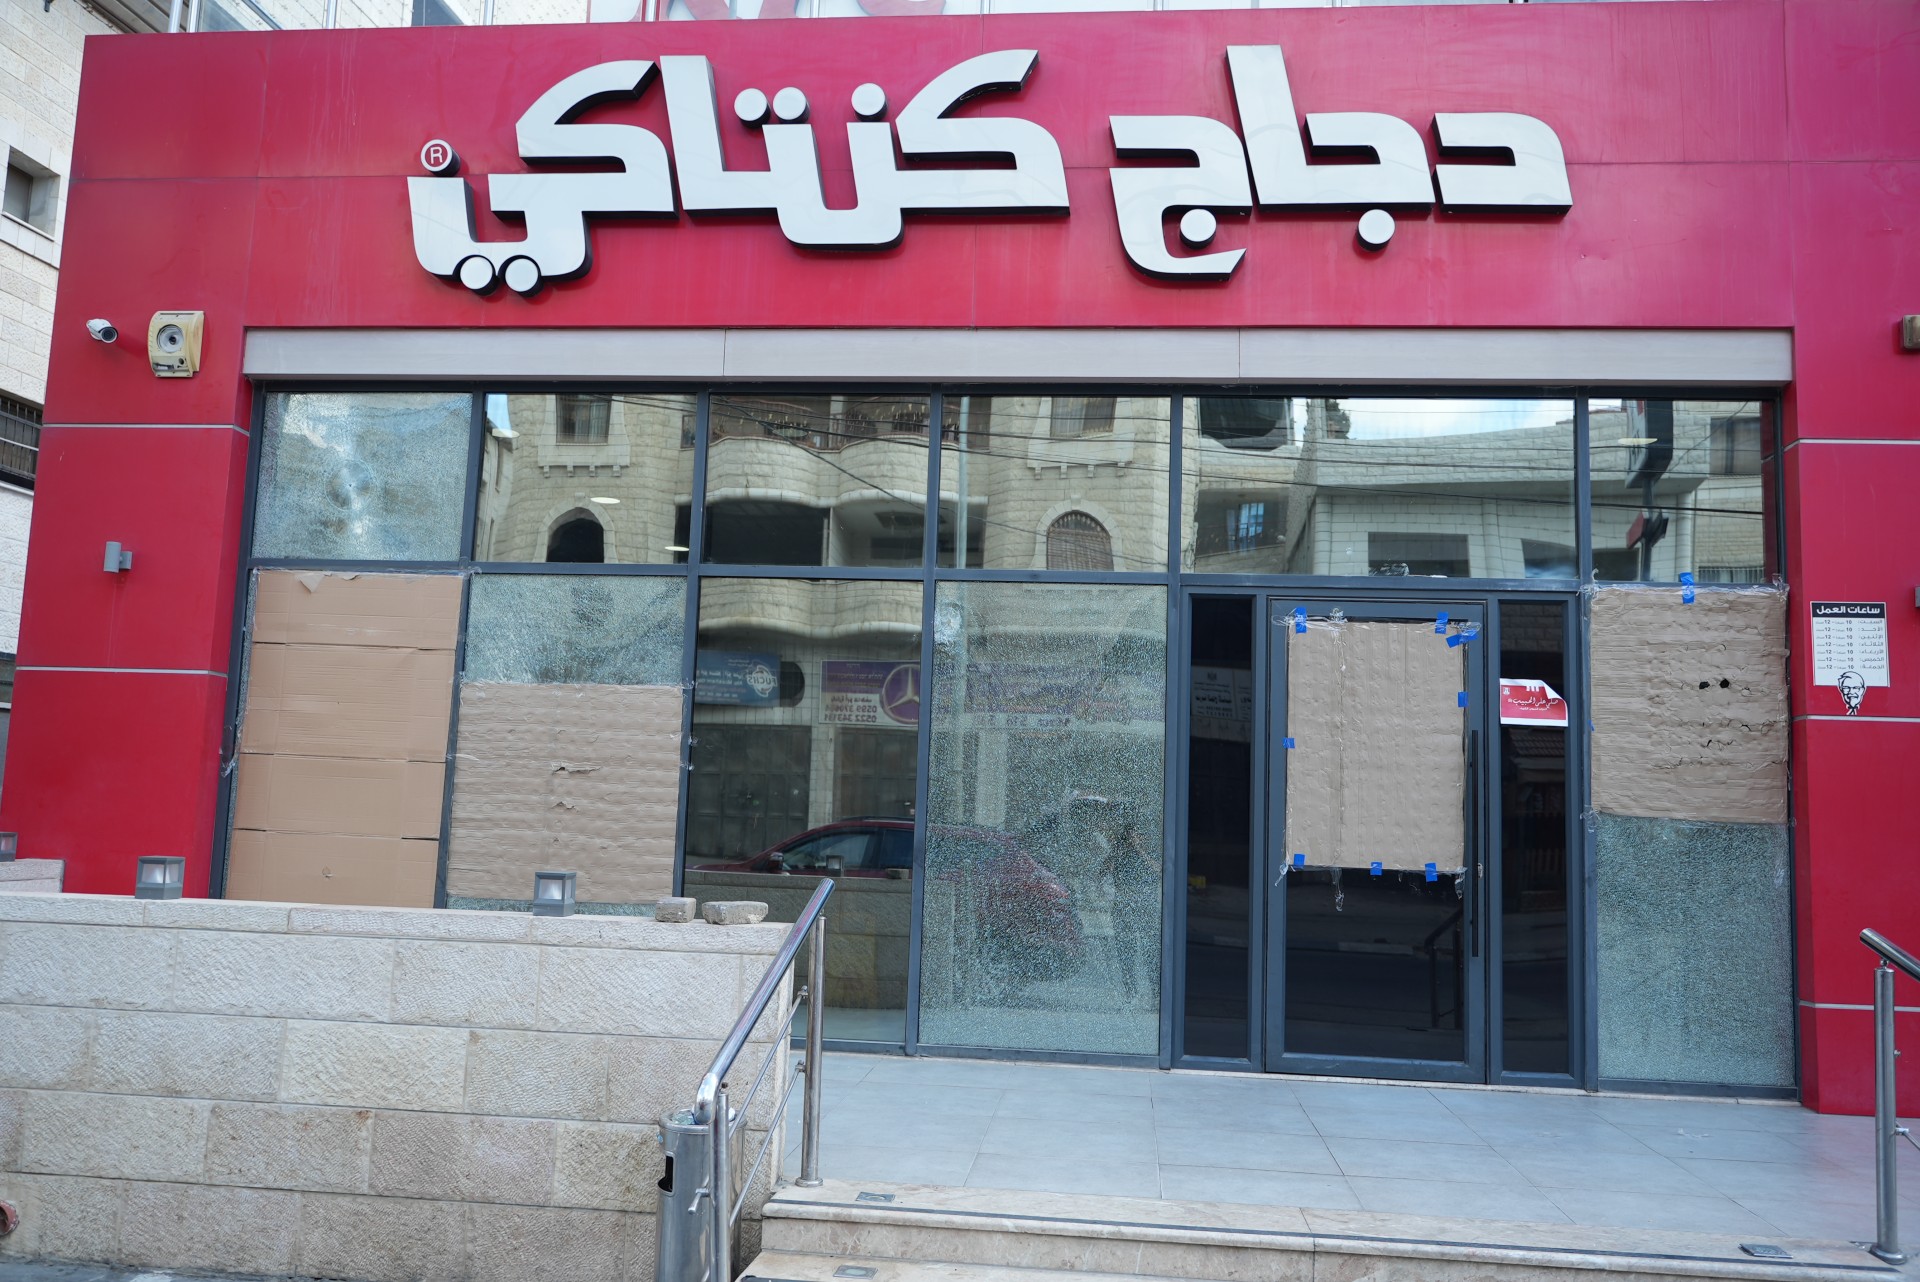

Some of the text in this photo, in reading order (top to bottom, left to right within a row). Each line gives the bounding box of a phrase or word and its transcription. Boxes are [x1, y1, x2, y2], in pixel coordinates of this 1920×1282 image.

[407, 49, 1069, 295] كنتاكي
[1110, 45, 1572, 282] دجاج
[1816, 606, 1880, 614] ساعات العمل
[1513, 696, 1536, 706] الحبيب
